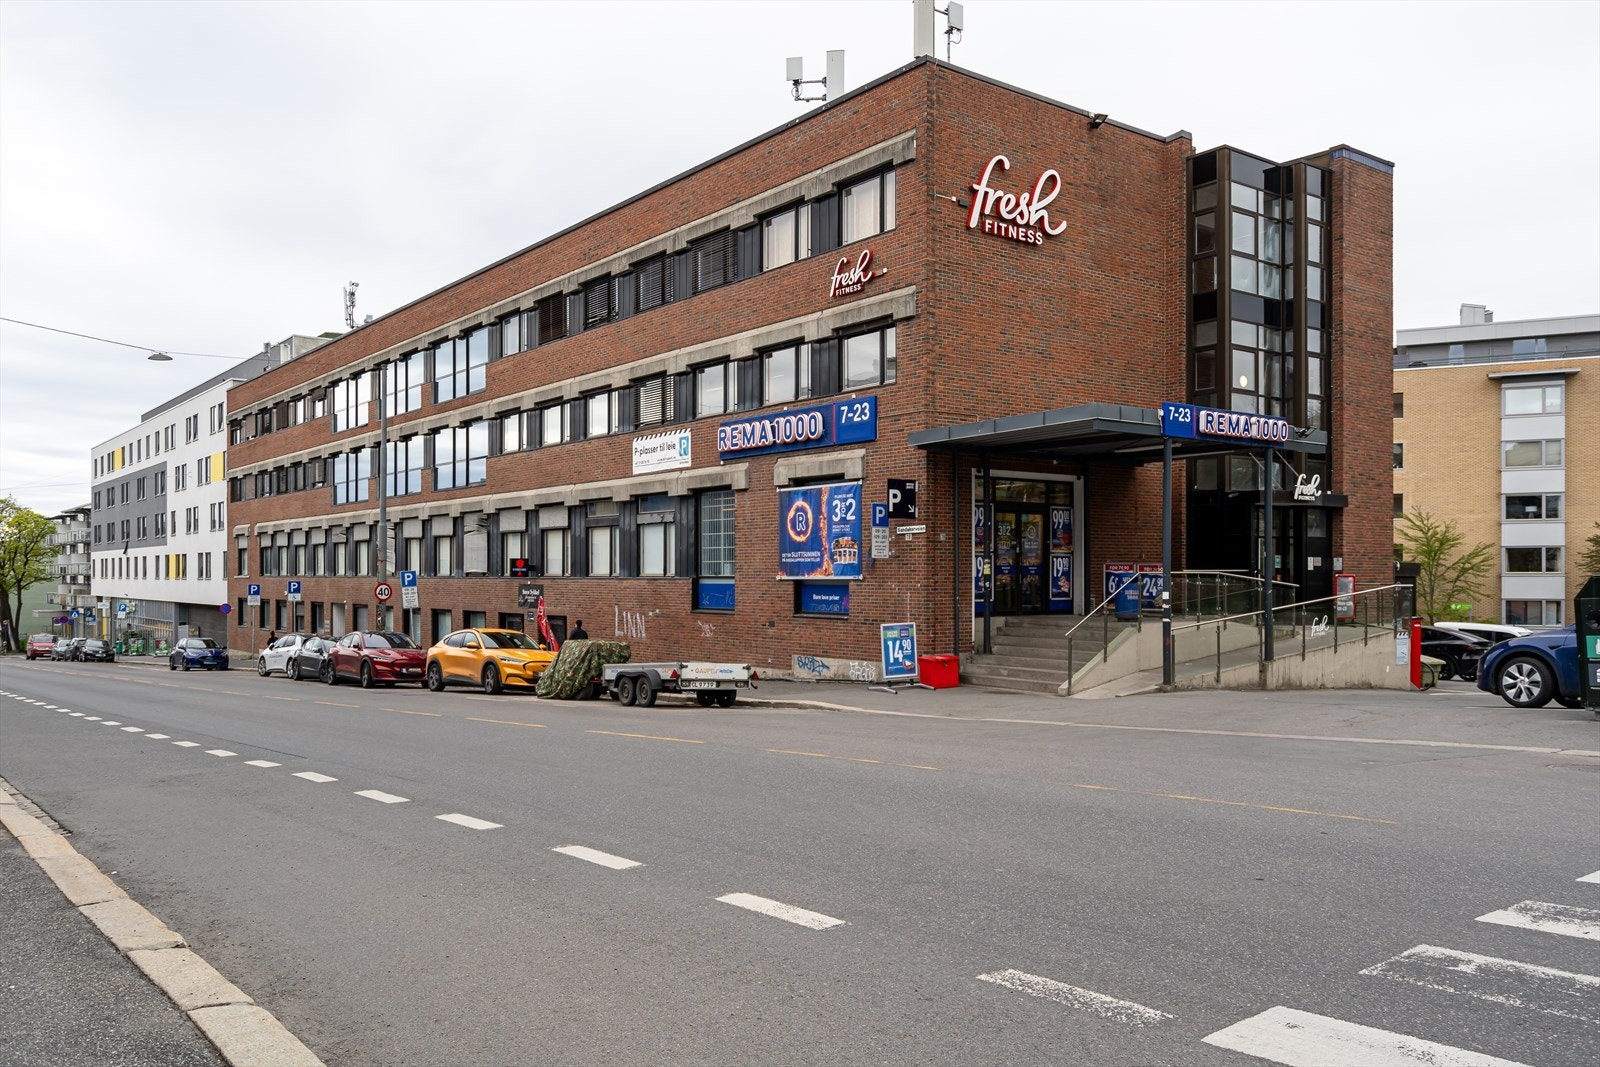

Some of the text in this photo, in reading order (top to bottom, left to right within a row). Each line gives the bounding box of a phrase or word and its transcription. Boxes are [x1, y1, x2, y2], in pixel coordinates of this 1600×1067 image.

[969, 154, 1067, 236] fresh
[985, 219, 1043, 245] FITNESS
[829, 249, 873, 298] fresh
[835, 283, 862, 297] FITNESS
[840, 402, 870, 424] 7-23
[1168, 406, 1191, 423] 7-23
[717, 411, 822, 451] REMA 1000
[1202, 410, 1289, 442] REMA 1000
[634, 446, 659, 458] P-plasser
[666, 441, 676, 451] leie
[1293, 473, 1322, 500] fresh
[832, 499, 841, 522] 3
[846, 498, 856, 520] 2
[888, 488, 902, 513] P
[795, 511, 806, 532] R
[875, 506, 886, 525] P
[1053, 510, 1064, 529] 99
[1053, 557, 1063, 577] 19
[291, 582, 299, 593] P
[404, 572, 413, 586] P
[1142, 577, 1157, 597] 24
[250, 585, 258, 595] P
[377, 587, 390, 597] 40
[120, 604, 127, 612] P
[614, 604, 646, 640] LINN
[887, 638, 912, 664] 14 90
